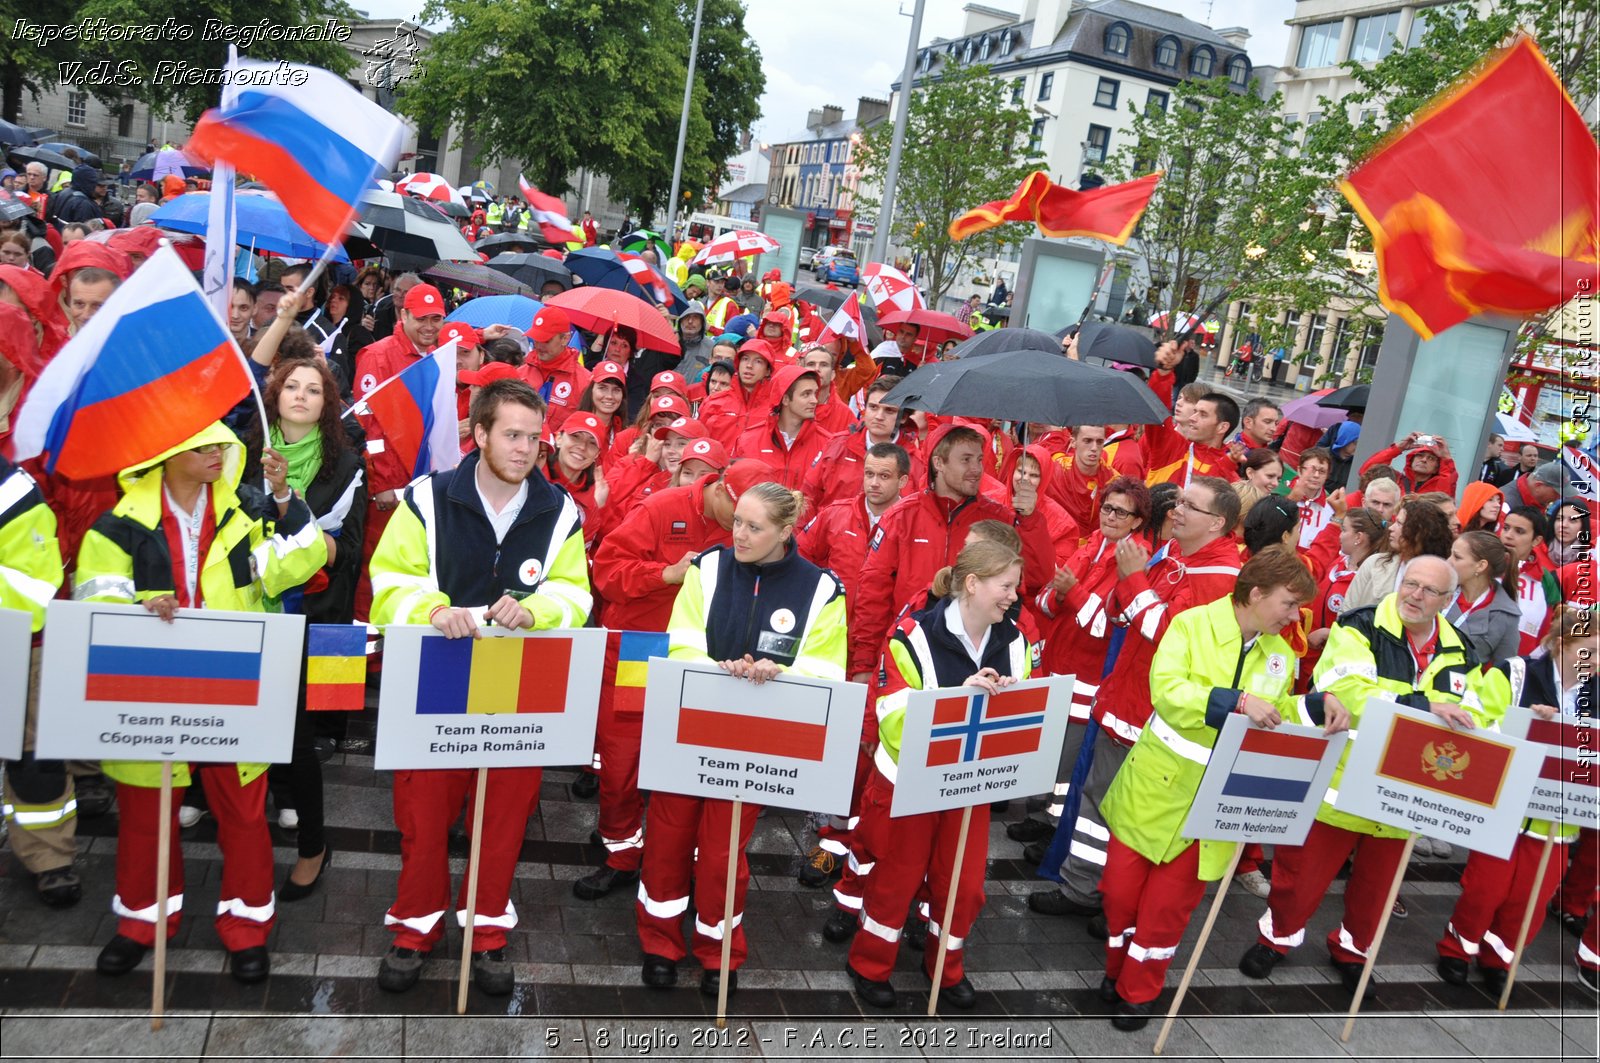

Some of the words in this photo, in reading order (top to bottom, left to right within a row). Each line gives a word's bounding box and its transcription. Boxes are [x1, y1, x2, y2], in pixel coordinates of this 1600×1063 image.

[117, 713, 164, 727] Team
[170, 715, 225, 728] Russia
[435, 724, 475, 736] Team
[480, 723, 543, 735] Romania
[99, 732, 174, 746] Сборная
[180, 734, 239, 746] России
[430, 741, 478, 754] Echipa
[483, 739, 545, 752] România
[698, 756, 740, 772] Team
[746, 761, 798, 779] Poland
[942, 771, 974, 782] Team
[976, 763, 1019, 777] Norway
[698, 773, 739, 788] Team
[744, 779, 795, 796] Polska
[939, 785, 981, 798] Teamet
[984, 777, 1018, 791] Norge
[1216, 803, 1242, 815] Team
[1244, 806, 1298, 819] Netherlands
[1376, 785, 1409, 802] Team
[1411, 795, 1485, 824] Montenegro
[1214, 819, 1240, 832] Team
[1242, 822, 1288, 834] Nederland
[1380, 802, 1404, 816] Тим
[1407, 809, 1439, 827] Црна
[1441, 819, 1471, 836] Гора
